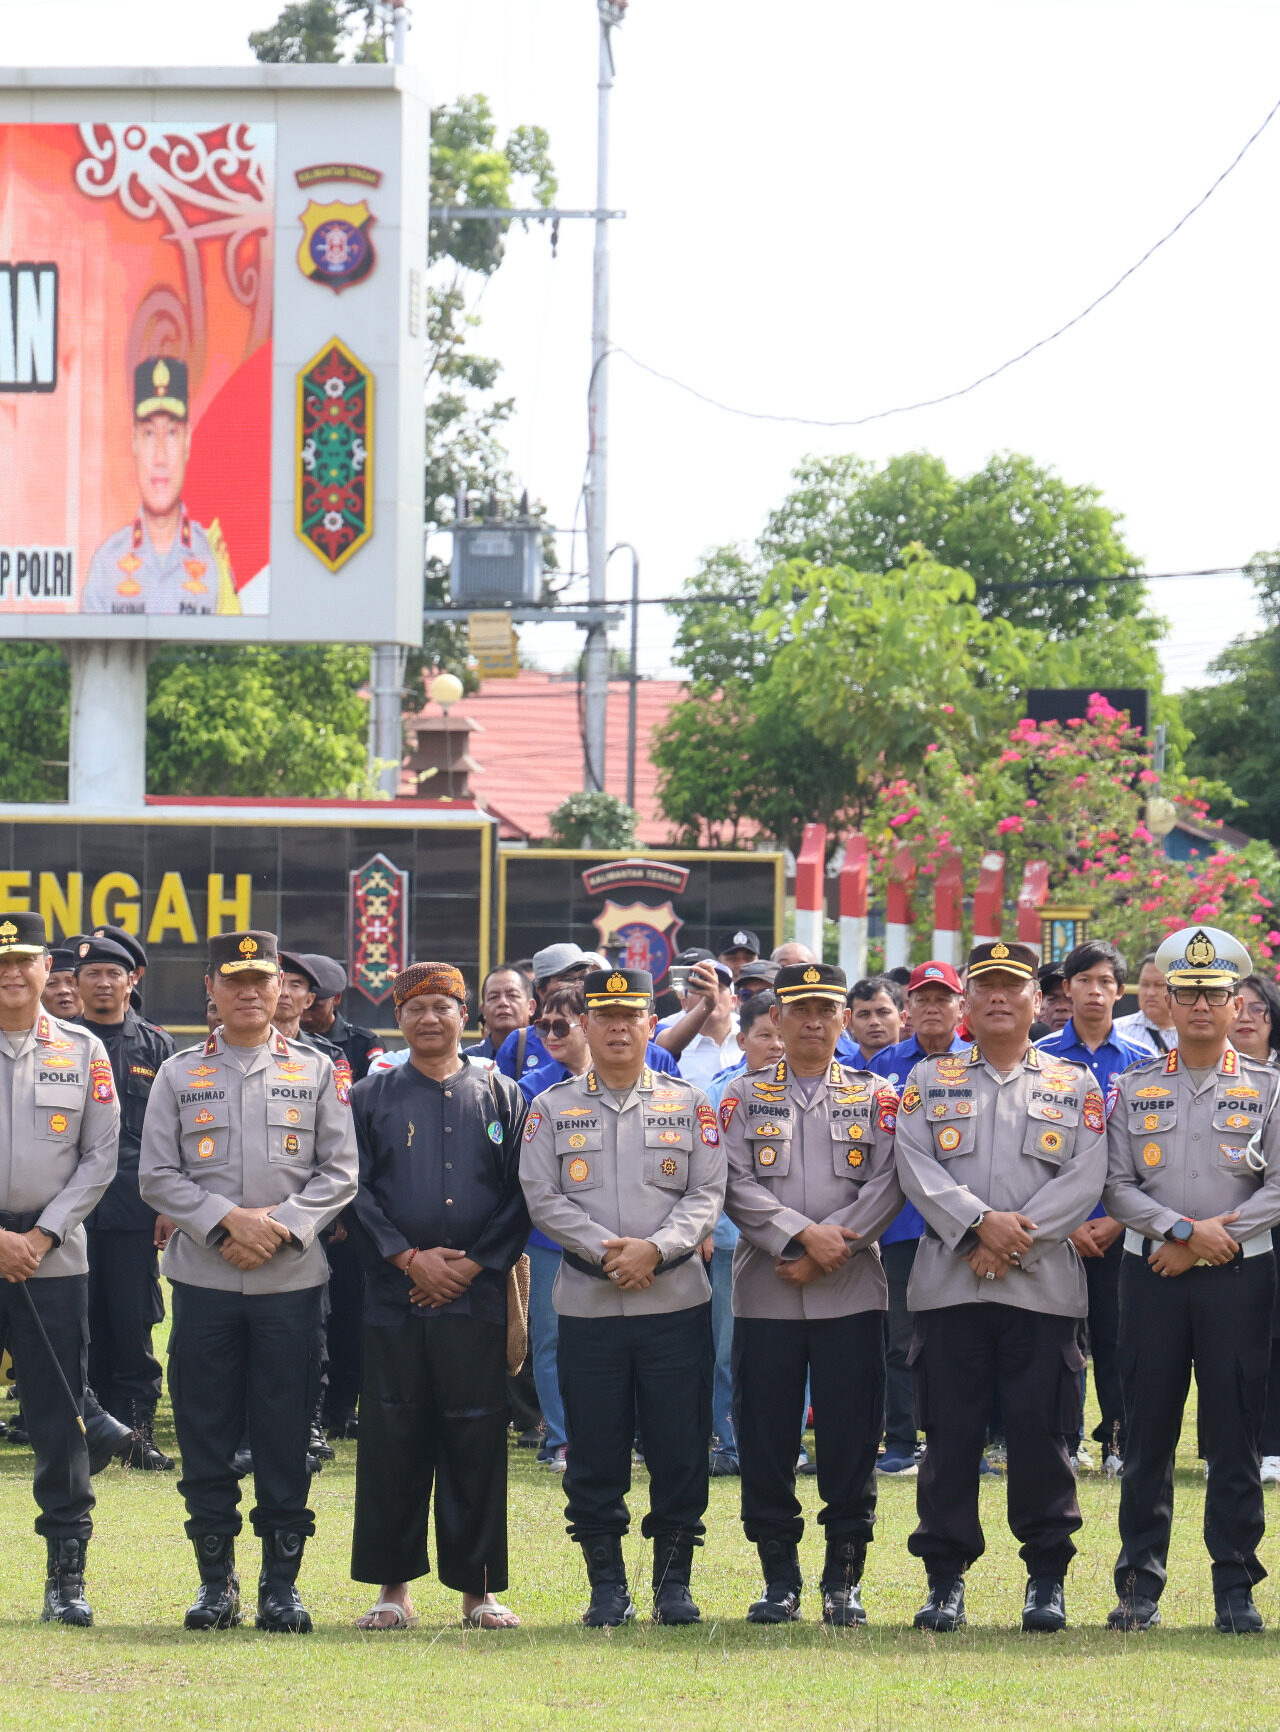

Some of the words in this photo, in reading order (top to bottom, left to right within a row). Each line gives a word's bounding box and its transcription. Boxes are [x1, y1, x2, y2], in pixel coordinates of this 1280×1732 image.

[17, 551, 72, 597] POLRI
[589, 868, 644, 886] KALIMANTAN
[646, 869, 682, 885] TENGAH
[39, 1072, 79, 1083] POLRI
[180, 1091, 225, 1104] RAKHMAD
[271, 1087, 313, 1100] POLRI
[1032, 1091, 1078, 1108] POLRI
[748, 1104, 790, 1118] SUGENG
[1131, 1100, 1174, 1112] YUSEP
[1218, 1100, 1263, 1114] POLRI
[556, 1118, 598, 1131] BENNY
[647, 1116, 691, 1128] POLRI
